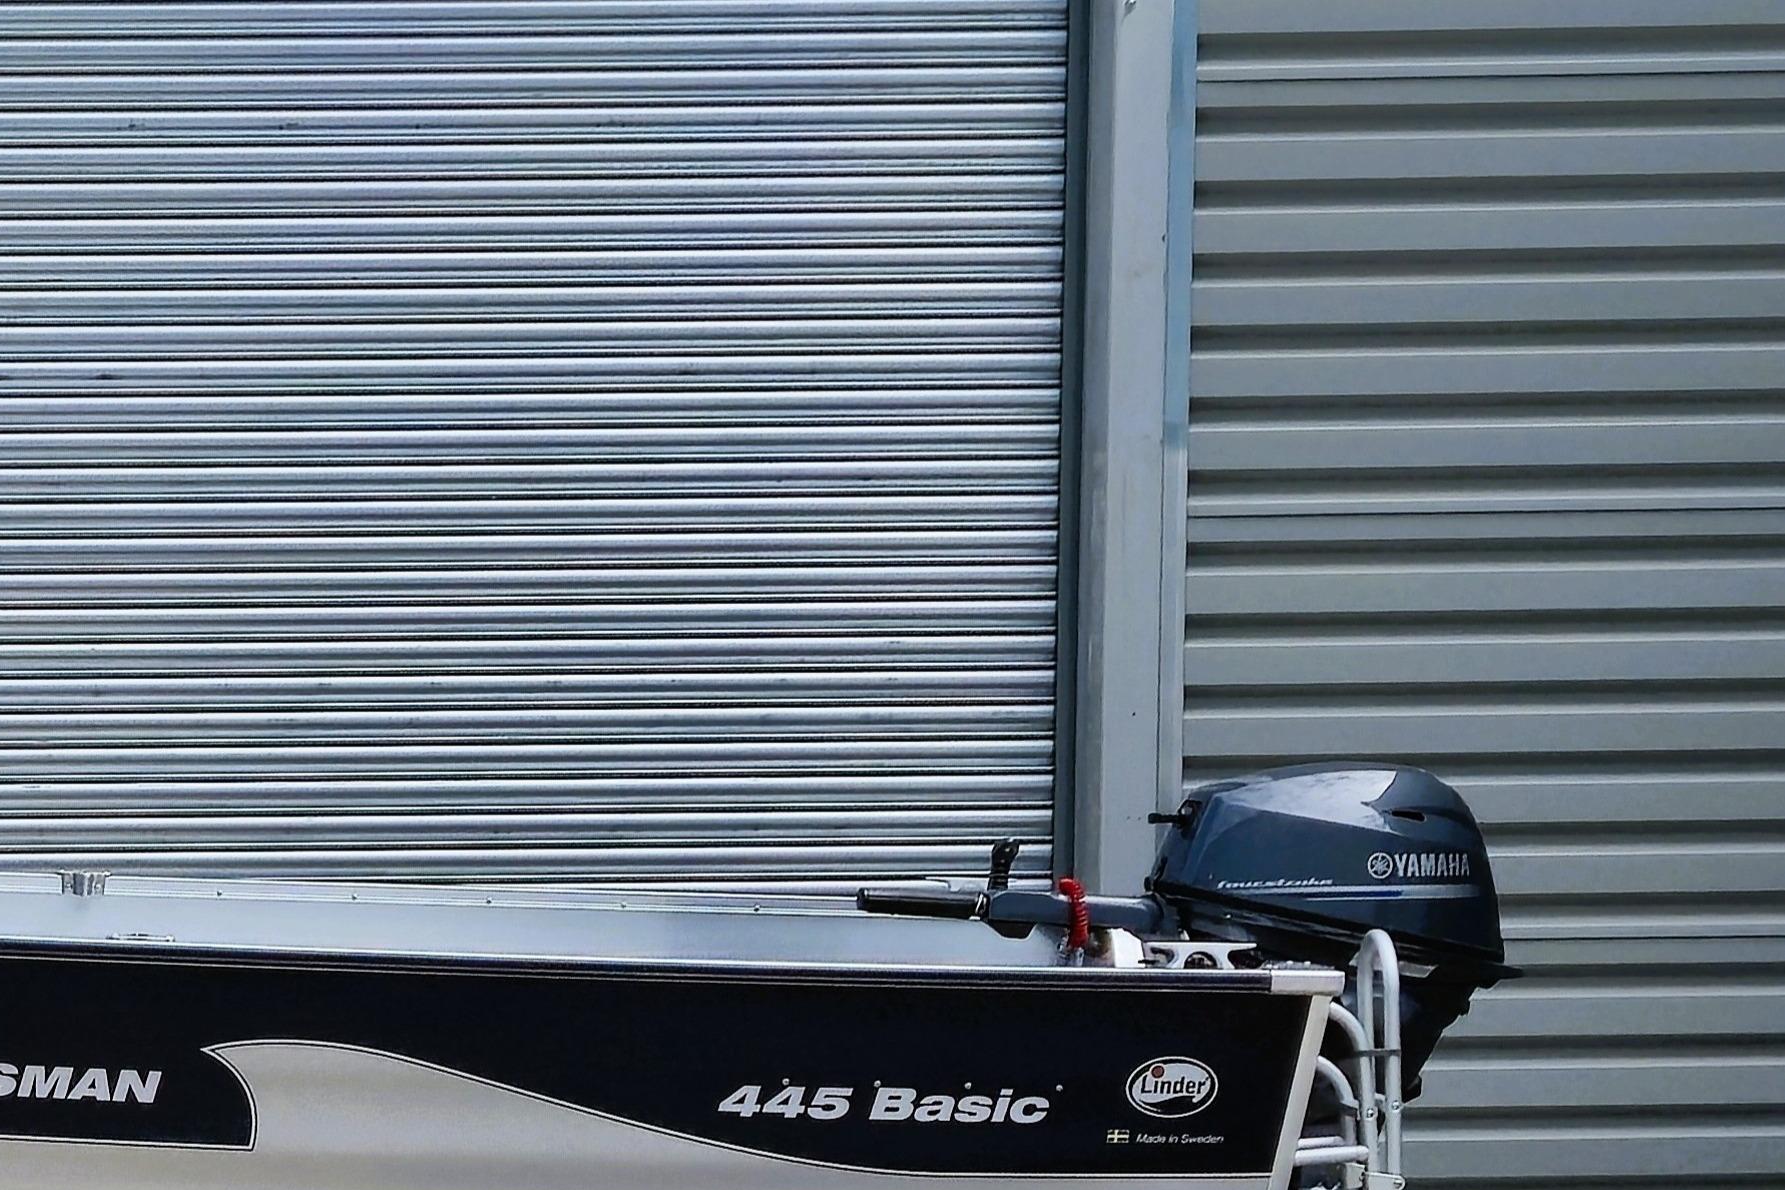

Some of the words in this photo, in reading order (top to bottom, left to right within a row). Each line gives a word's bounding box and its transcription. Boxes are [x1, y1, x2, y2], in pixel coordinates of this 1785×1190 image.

[1394, 852, 1470, 877] YAMAHA
[1140, 1066, 1209, 1095] Linder
[718, 1085, 853, 1120] 445
[869, 1087, 1050, 1123] Basic
[1136, 1133, 1167, 1144] Made
[1168, 1133, 1178, 1144] in
[1181, 1133, 1224, 1144] Sweden
